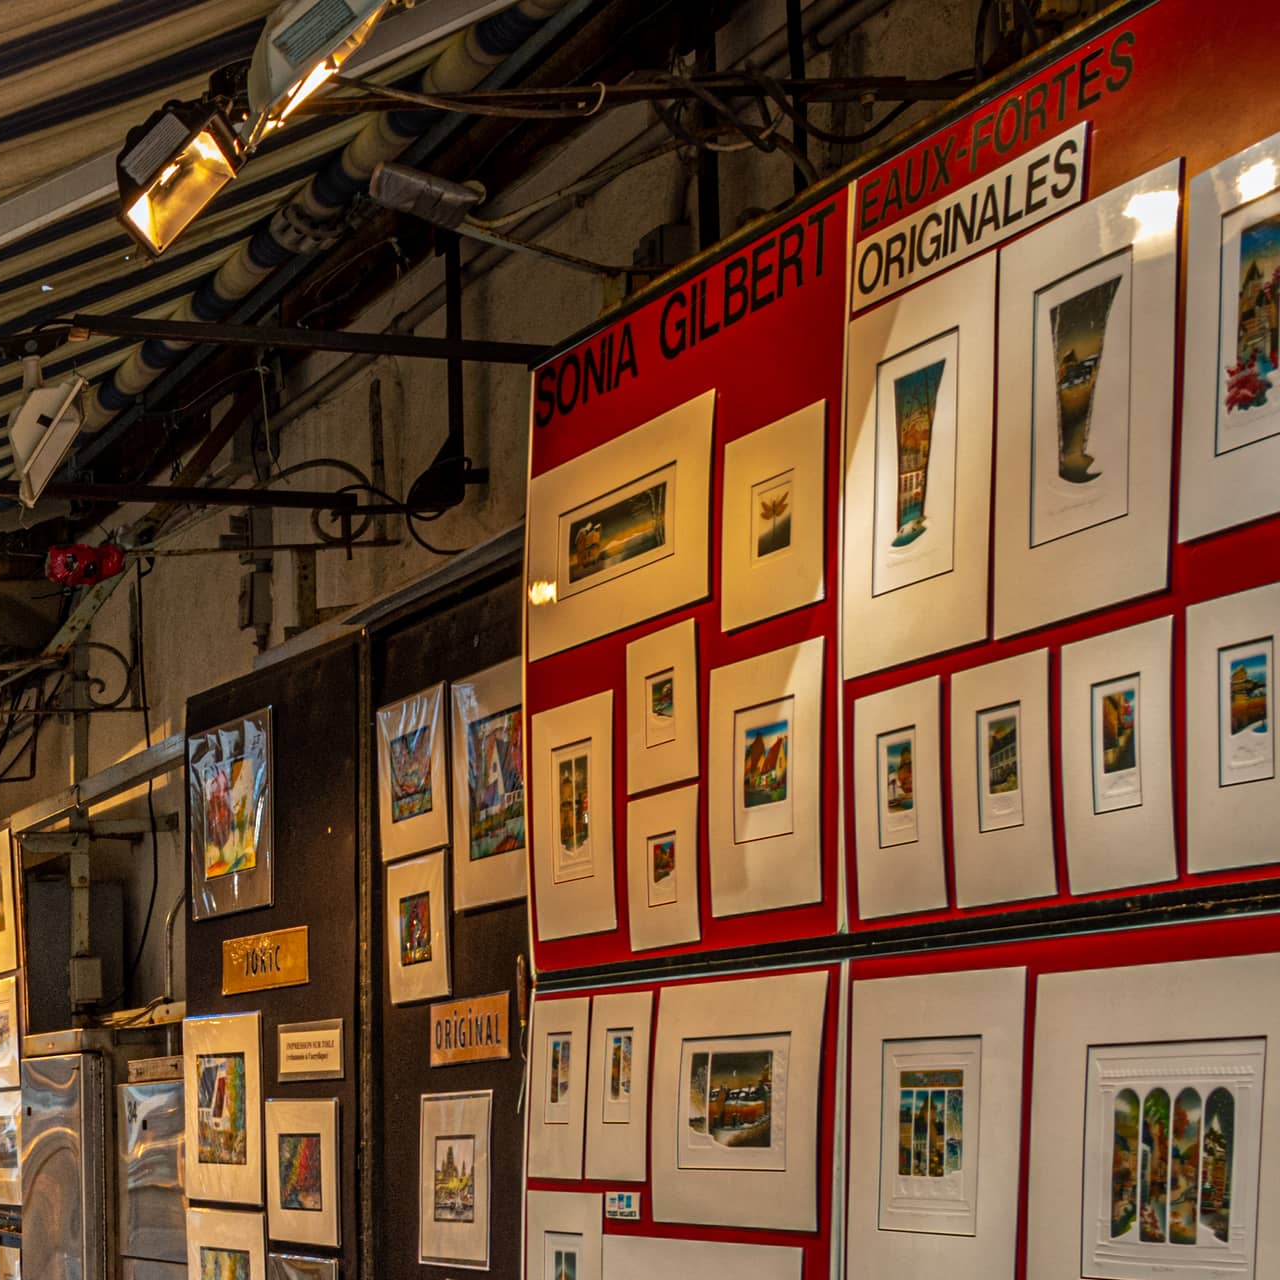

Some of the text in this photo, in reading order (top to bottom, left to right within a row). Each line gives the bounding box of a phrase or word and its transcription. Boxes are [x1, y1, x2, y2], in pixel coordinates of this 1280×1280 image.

[857, 138, 1080, 296] ORIGINALES
[859, 30, 1137, 234] EAUX-FORTES
[536, 201, 837, 428] SONIA GILBERT
